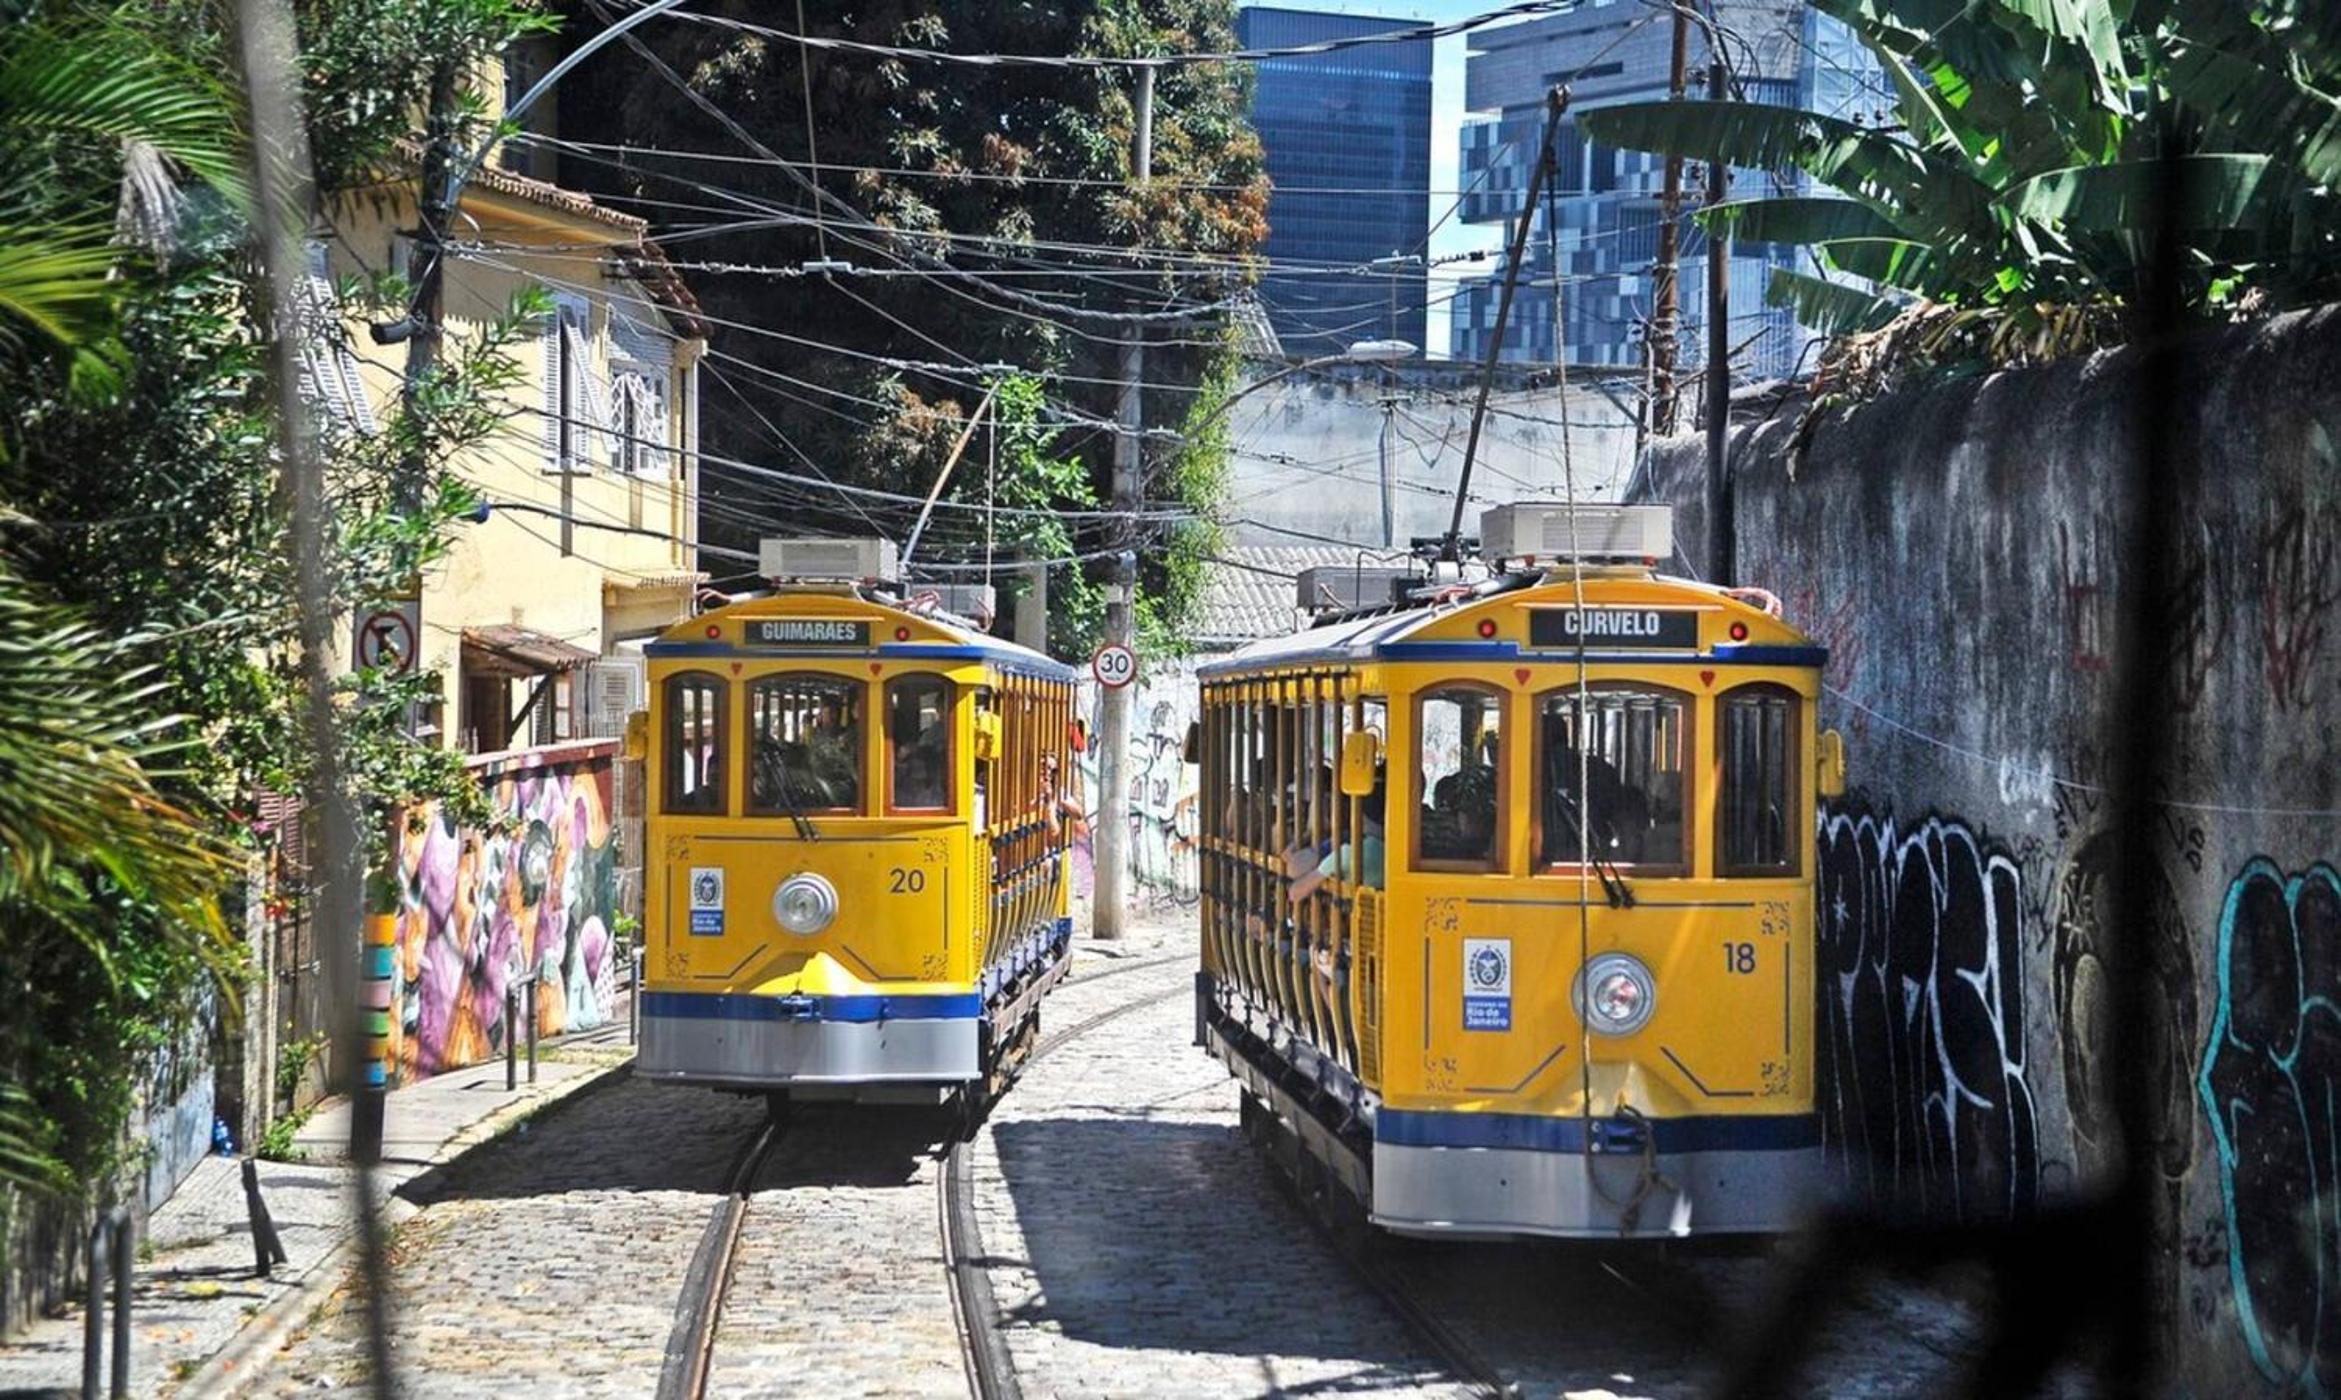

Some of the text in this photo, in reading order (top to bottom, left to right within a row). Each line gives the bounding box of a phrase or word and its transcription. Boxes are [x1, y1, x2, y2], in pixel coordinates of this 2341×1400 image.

[762, 622, 857, 641] GUIMARAES
[1564, 611, 1660, 636] CURVELO
[1101, 652, 1129, 674] 30
[890, 868, 925, 893] 20
[1723, 942, 1756, 974] 18
